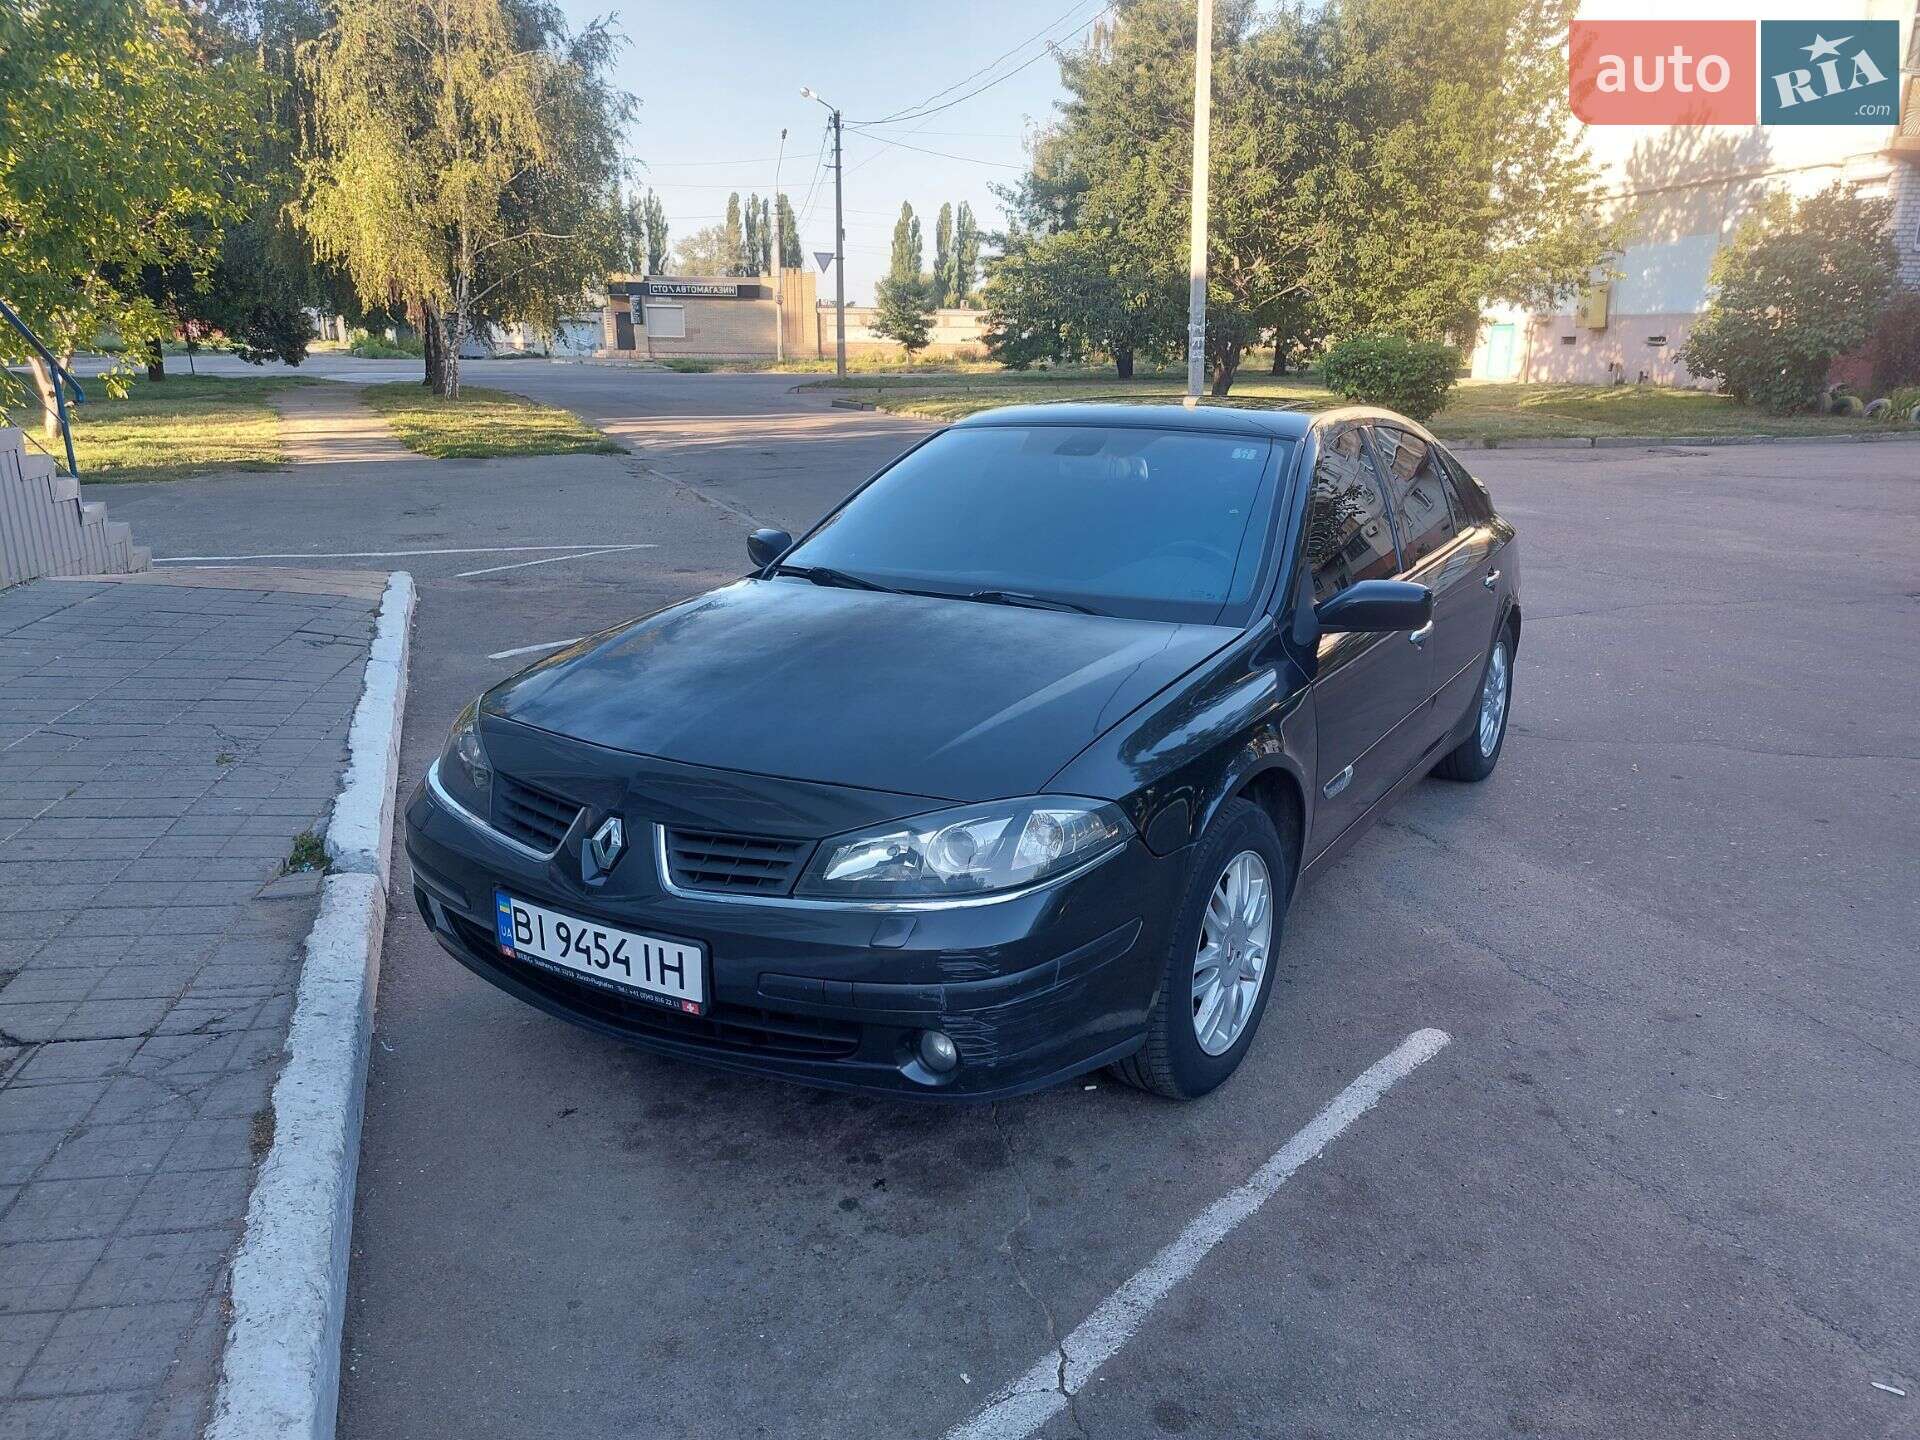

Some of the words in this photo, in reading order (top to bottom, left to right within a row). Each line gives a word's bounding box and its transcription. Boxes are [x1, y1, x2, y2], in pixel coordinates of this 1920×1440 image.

[652, 285, 668, 293] СТО
[676, 285, 735, 294] АВТОМАГАЗИН
[501, 928, 512, 939] UA
[513, 906, 545, 951] BI
[555, 922, 631, 977] 9454
[644, 944, 685, 990] IH
